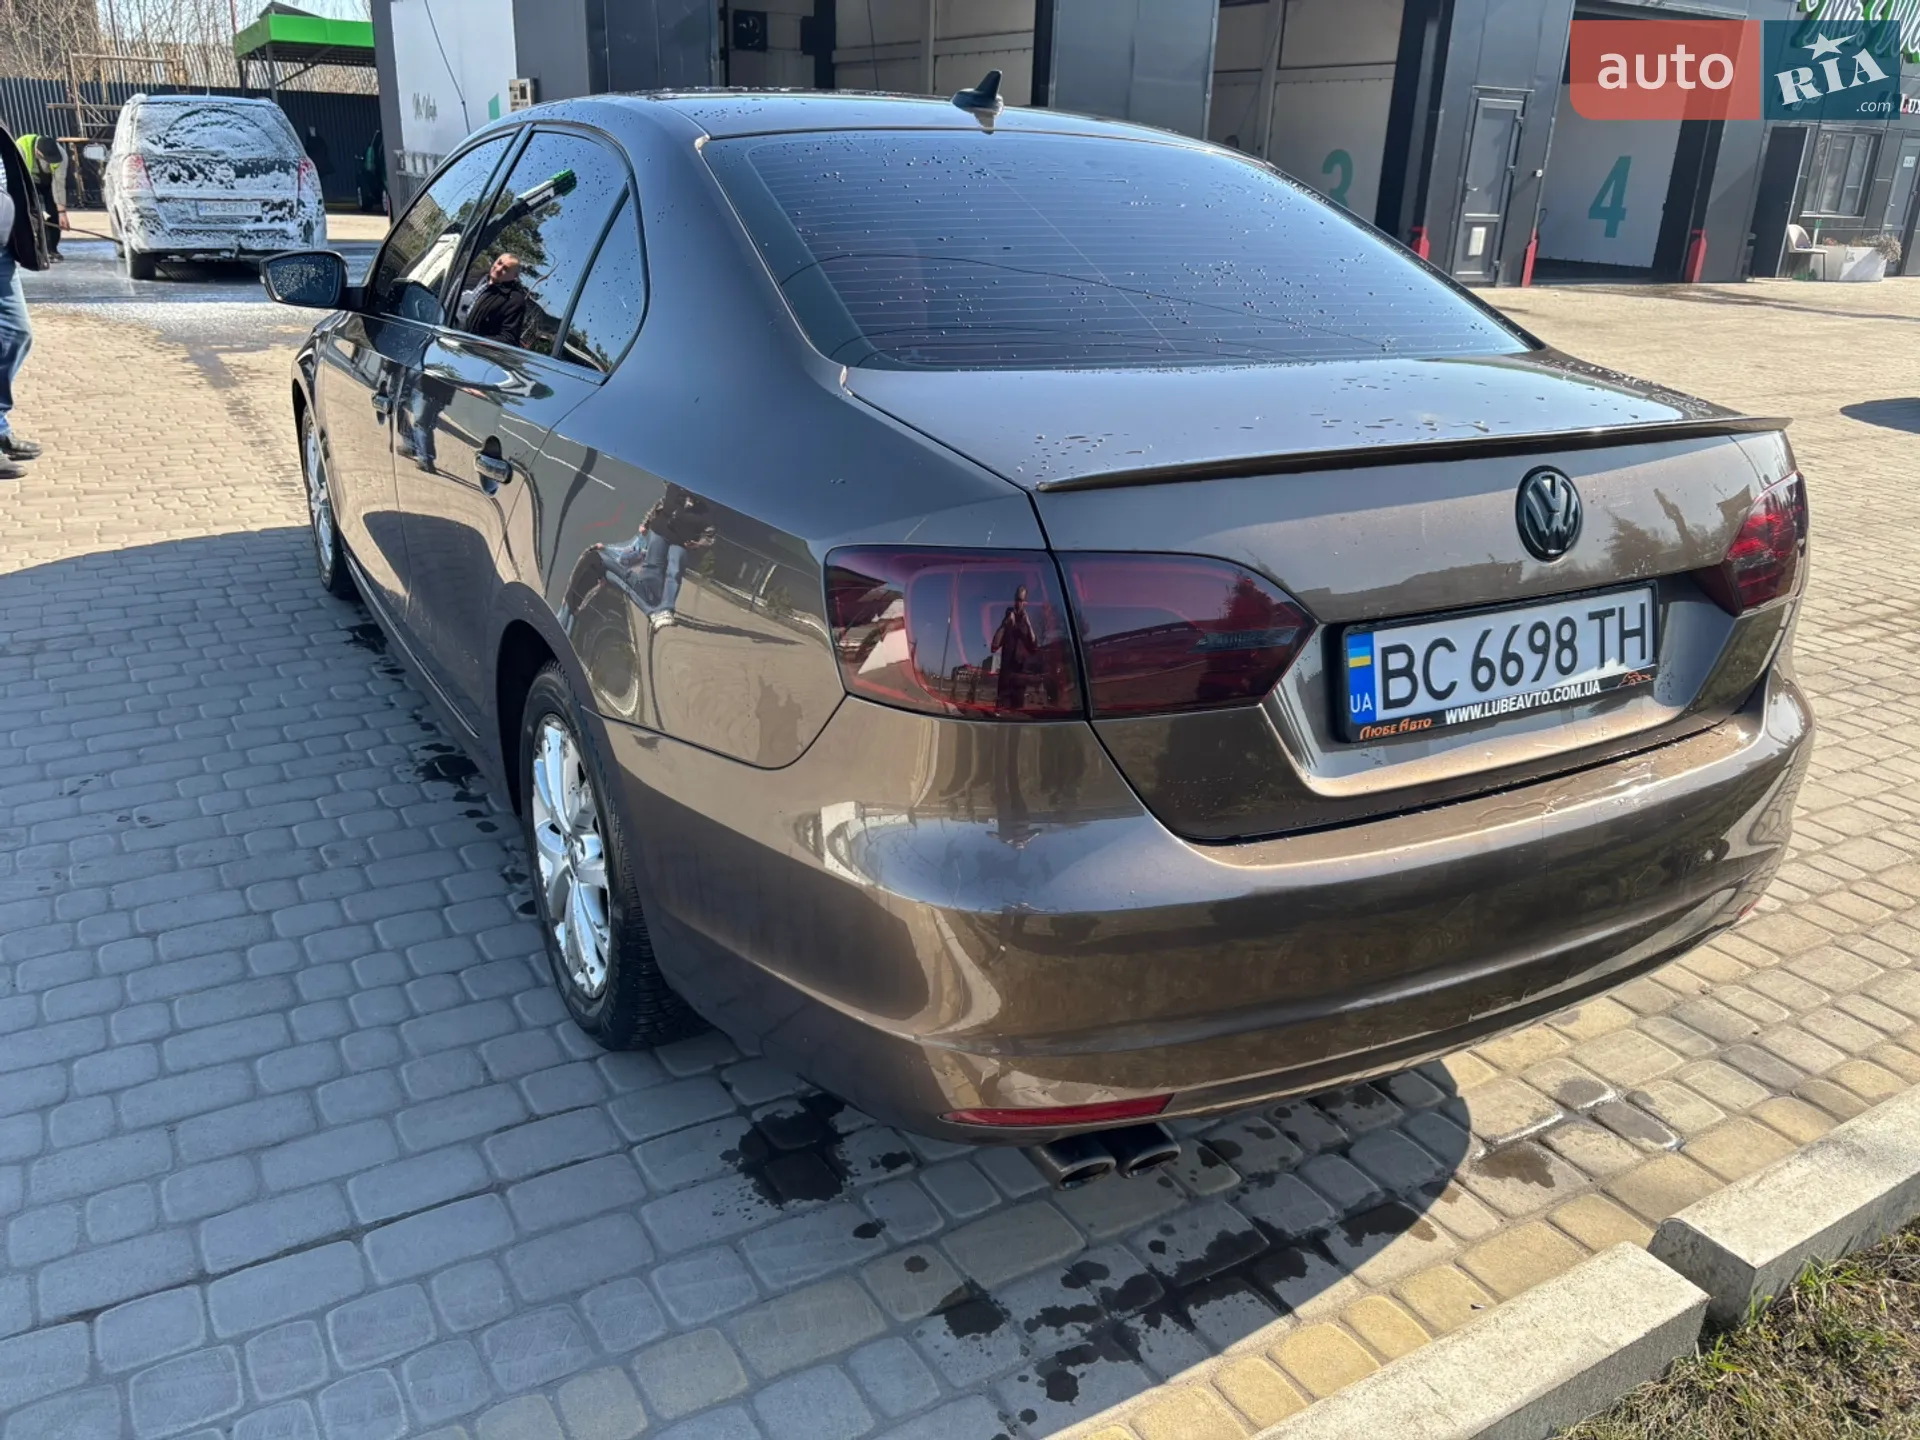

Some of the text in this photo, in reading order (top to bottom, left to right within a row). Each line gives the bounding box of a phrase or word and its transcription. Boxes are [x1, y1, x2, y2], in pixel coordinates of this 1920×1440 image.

[1322, 149, 1353, 208] 3
[1588, 156, 1631, 238] 4
[1381, 602, 1646, 711] BC 6698 TH
[1350, 692, 1373, 713] UA
[1445, 680, 1601, 725] WWW.LUBEAVTO.COM.UA
